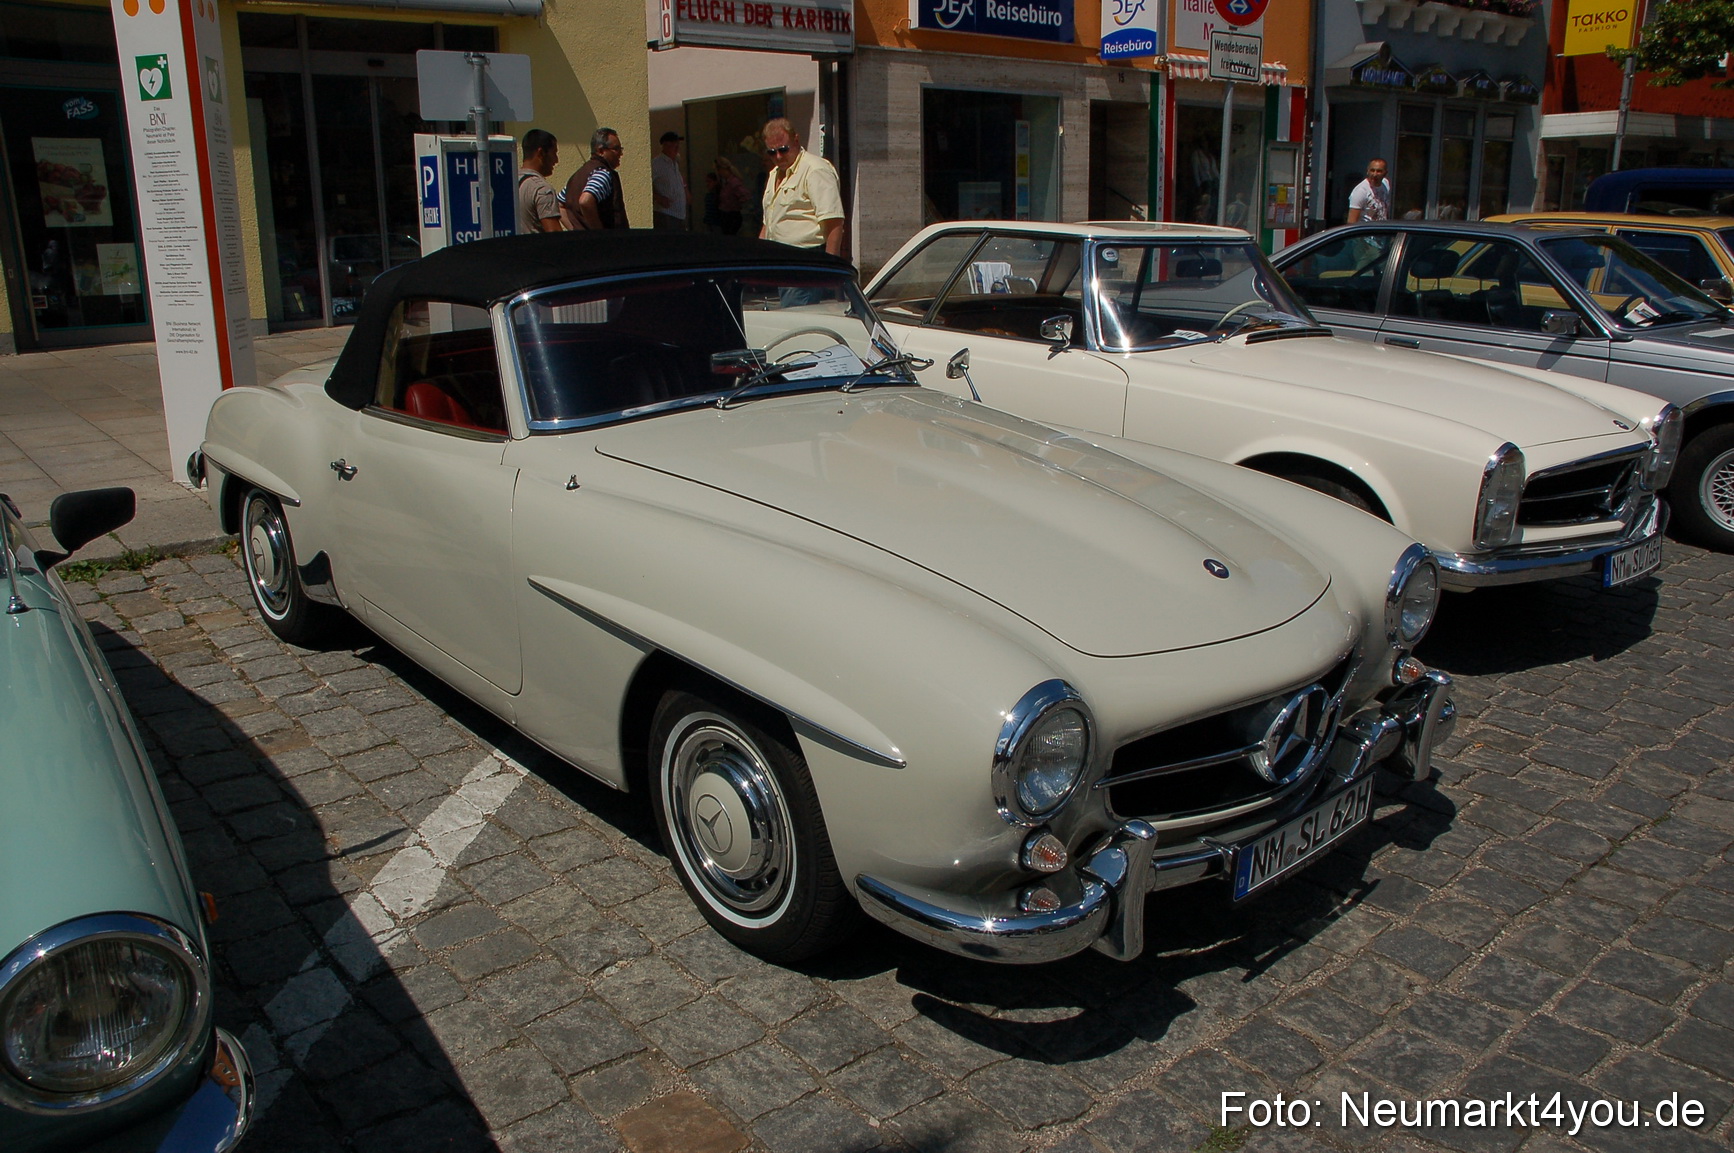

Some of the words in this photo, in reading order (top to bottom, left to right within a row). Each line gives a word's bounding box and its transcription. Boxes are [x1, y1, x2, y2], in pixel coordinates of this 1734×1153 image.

[986, 0, 1063, 27] Reisebüro
[1183, 0, 1216, 15] Italie
[677, 0, 735, 23] FLUCH
[743, 2, 774, 28] DER
[782, 6, 852, 33] KARIBIK
[1578, 24, 1618, 33] FASHION
[1104, 40, 1153, 55] Reisebüro
[1214, 39, 1259, 56] Wendebereich
[1118, 73, 1125, 83] 15
[65, 98, 81, 108] vom
[66, 101, 94, 119] FASS
[149, 112, 167, 126] BNI
[456, 158, 504, 175] HIR
[424, 165, 435, 198] P
[1633, 547, 1644, 573] SL
[1250, 830, 1287, 884] NM
[1295, 811, 1325, 856] SL
[1329, 780, 1370, 836] 62H
[1238, 877, 1245, 888] D
